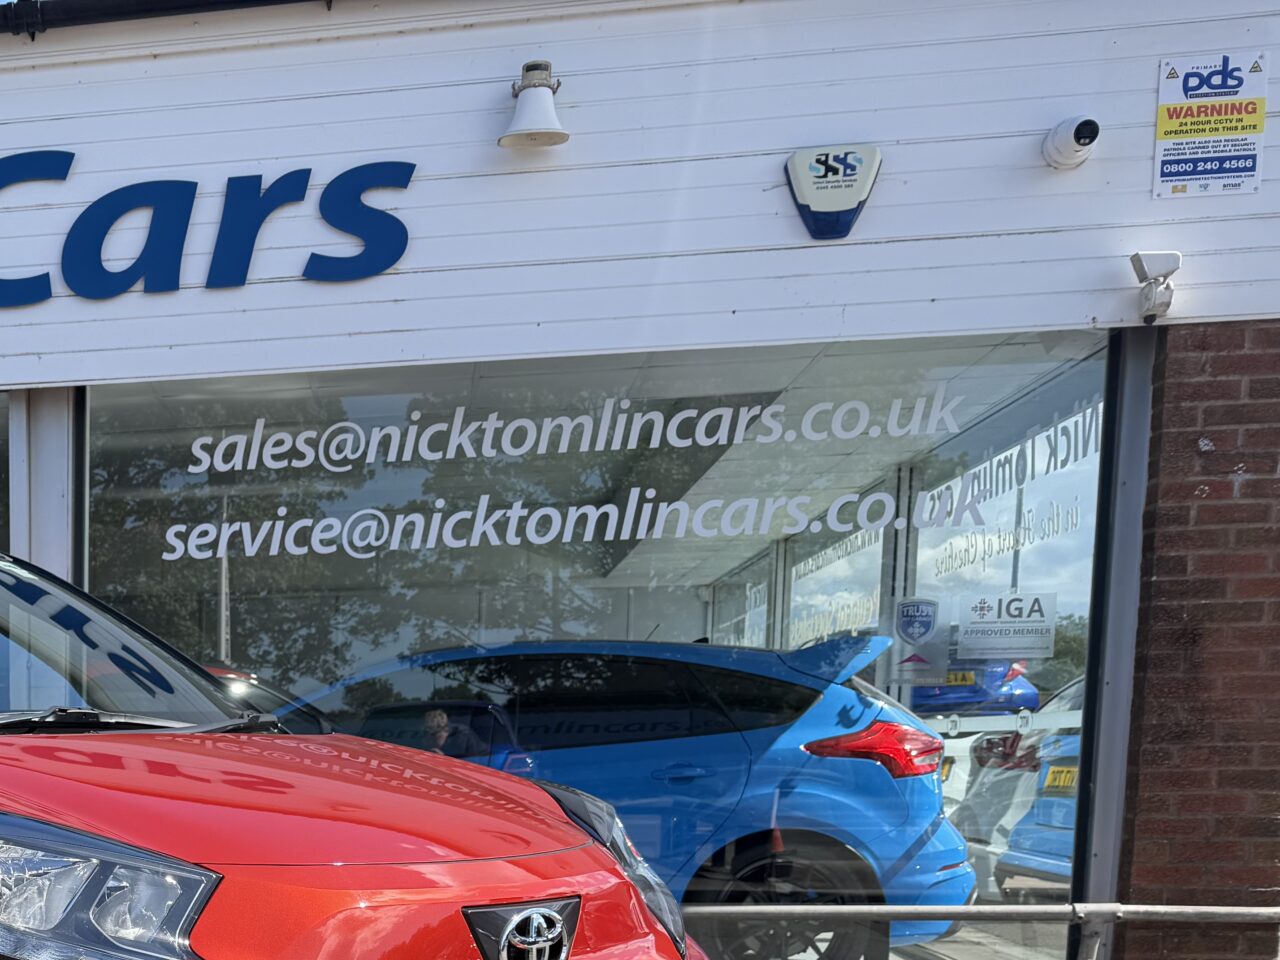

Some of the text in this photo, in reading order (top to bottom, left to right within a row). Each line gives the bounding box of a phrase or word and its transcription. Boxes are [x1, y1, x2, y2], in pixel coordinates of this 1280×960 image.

[1183, 55, 1244, 100] pds
[1166, 101, 1258, 120] WARNING
[1190, 119, 1211, 127] HOUR
[1163, 128, 1206, 136] OPERATION
[1163, 158, 1253, 173] 0800 240 4566
[187, 380, 965, 474] sales@nicktomlincars.co.uk
[161, 472, 988, 560] service@nicktomlincars.co.uk
[903, 605, 932, 616] TRUST
[997, 597, 1045, 620] IGA
[963, 627, 1051, 637] APPROVED MEMBER
